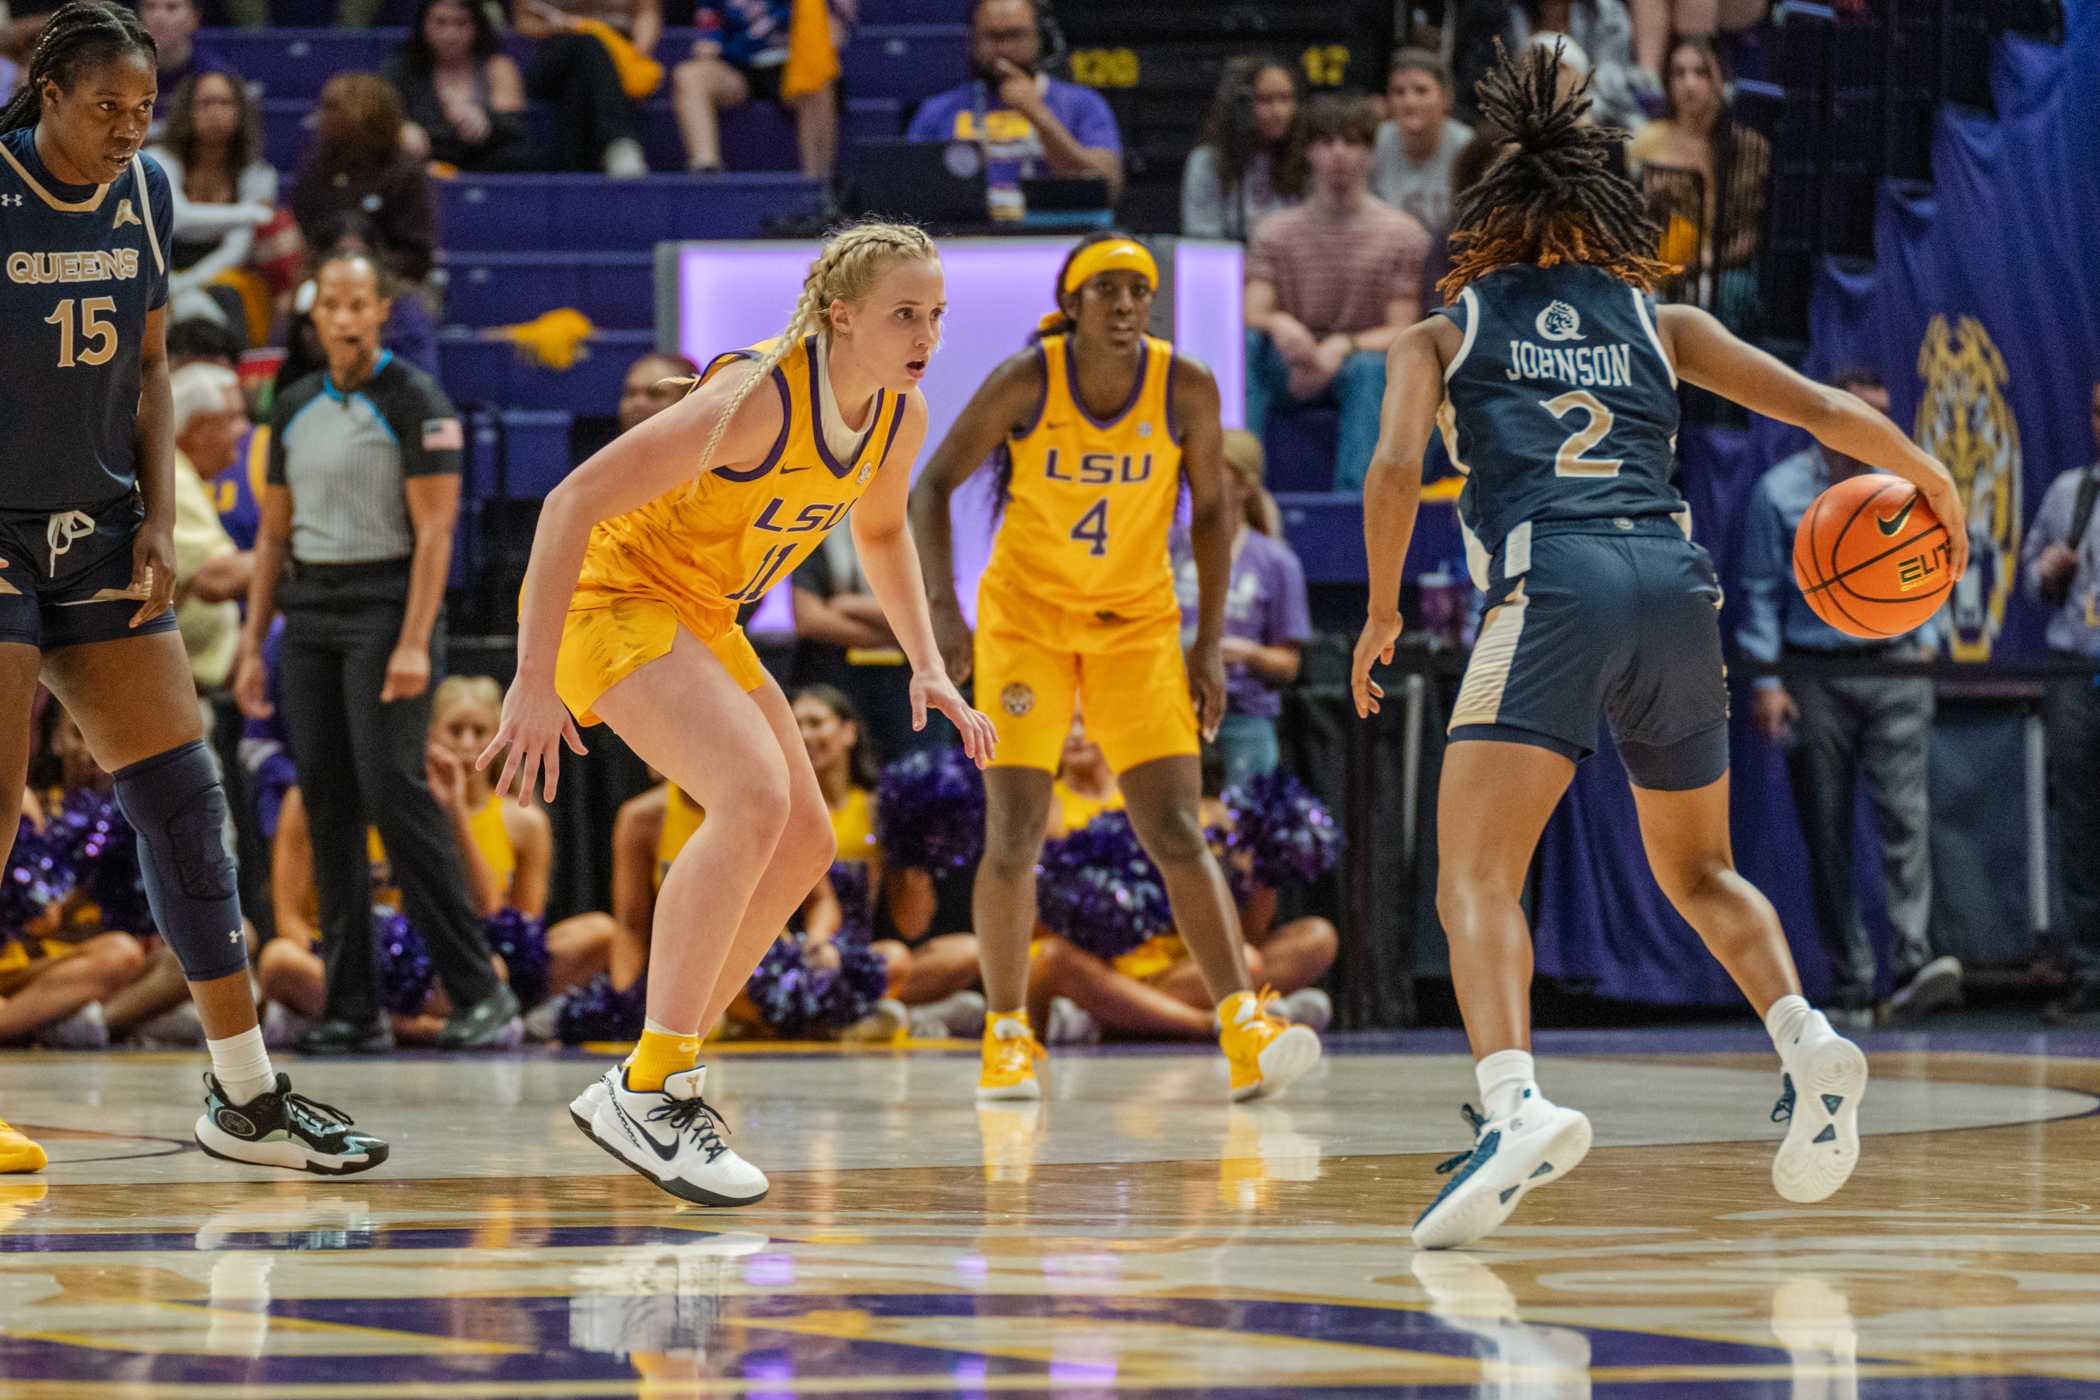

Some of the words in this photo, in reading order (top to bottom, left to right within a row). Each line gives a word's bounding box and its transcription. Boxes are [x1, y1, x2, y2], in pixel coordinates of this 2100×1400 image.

[7, 248, 139, 284] QUEENS
[44, 296, 118, 367] 15
[1506, 340, 1632, 386] JOHNSON
[1538, 390, 1624, 477] 2
[1045, 448, 1152, 483] LSU
[753, 497, 858, 532] LSU
[1070, 498, 1107, 556] 4
[724, 543, 798, 601] 11
[1898, 541, 1951, 583] ELIT
